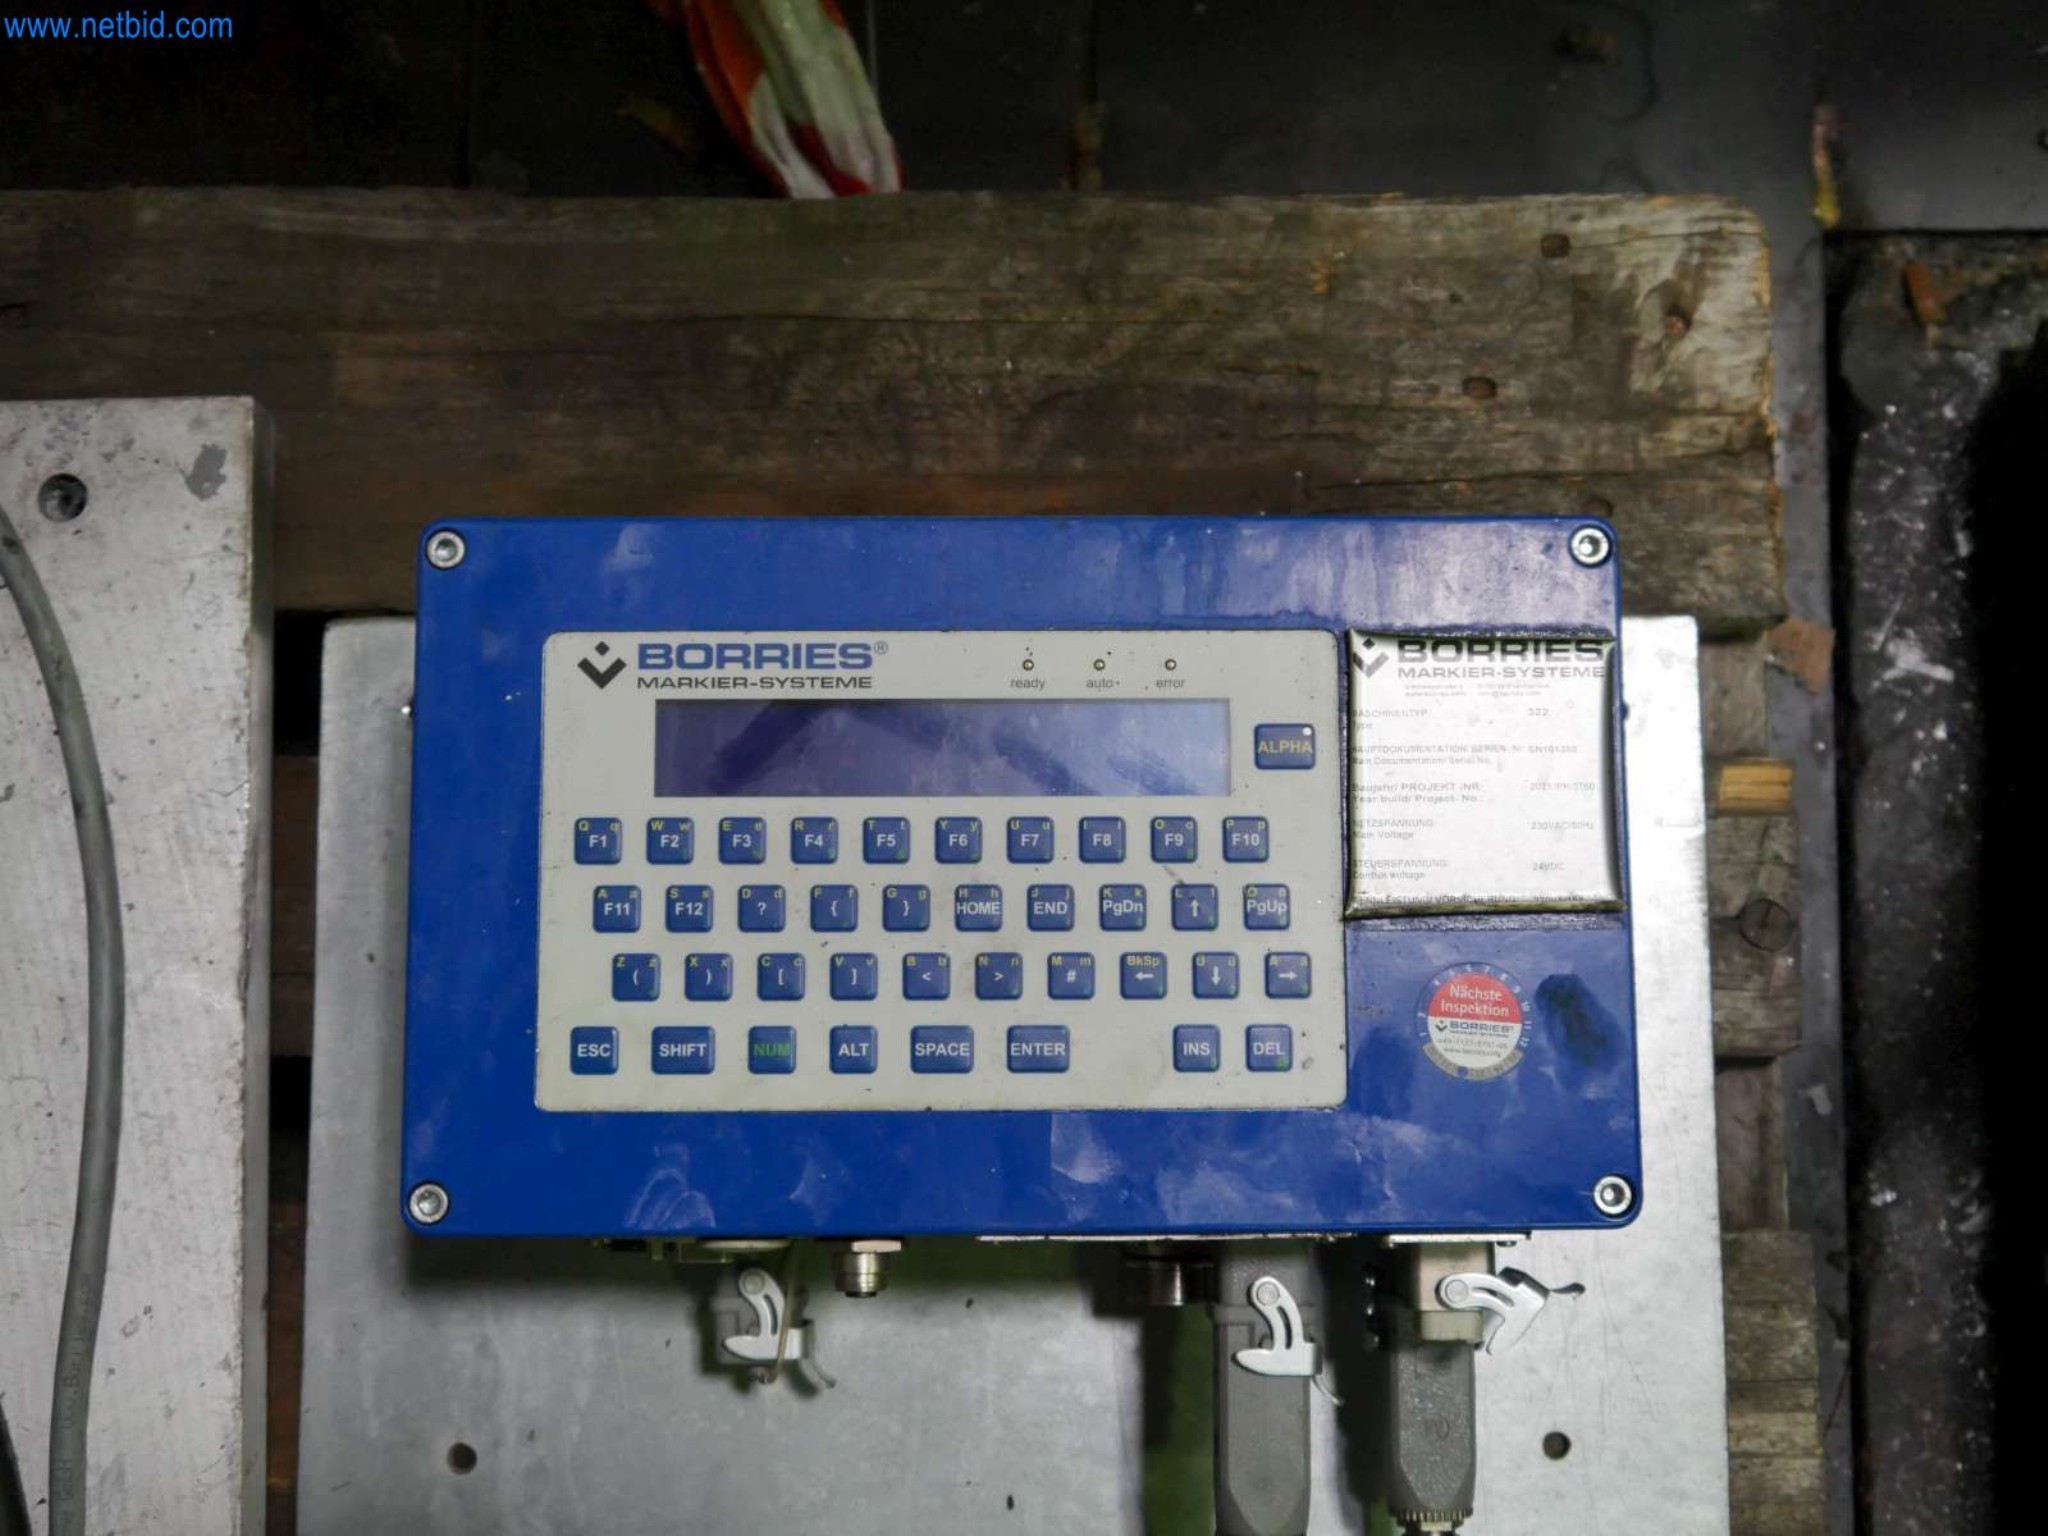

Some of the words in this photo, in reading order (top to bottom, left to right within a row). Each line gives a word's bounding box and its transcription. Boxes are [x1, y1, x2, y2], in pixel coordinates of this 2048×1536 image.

[1397, 638, 1604, 663] BORRIES
[1398, 666, 1607, 679] MARKIER-SYSTEME
[637, 676, 873, 689] MARKIER-SYSTEME
[1010, 678, 1045, 690] ready
[1086, 678, 1114, 688] auto
[1156, 678, 1185, 688] error
[1258, 740, 1313, 754] ALPHA
[589, 835, 607, 848] F1
[660, 834, 680, 848] F2
[732, 834, 751, 847] F3
[804, 834, 823, 847] F4
[877, 834, 896, 847] F5
[949, 834, 968, 847] F6
[1021, 834, 1040, 847] F7
[1093, 833, 1112, 846] F8
[1164, 833, 1184, 846] F9
[1232, 833, 1260, 846] F10
[604, 902, 630, 916] F11
[675, 902, 704, 916] F12
[956, 902, 1001, 915] HOME
[1033, 902, 1068, 915] END
[1102, 900, 1144, 916] PgDn
[1246, 900, 1288, 915] PgUp
[1449, 984, 1502, 1001] Nächste
[1441, 999, 1509, 1017] Inspektion
[577, 1043, 611, 1057] ESC
[659, 1043, 707, 1057] SHIFT
[754, 1044, 790, 1056] NUM
[838, 1043, 869, 1056] ALT
[915, 1042, 970, 1056] SPACE
[1010, 1042, 1065, 1056] ENTER
[1183, 1042, 1210, 1055] INS
[1253, 1042, 1286, 1055] DEL
